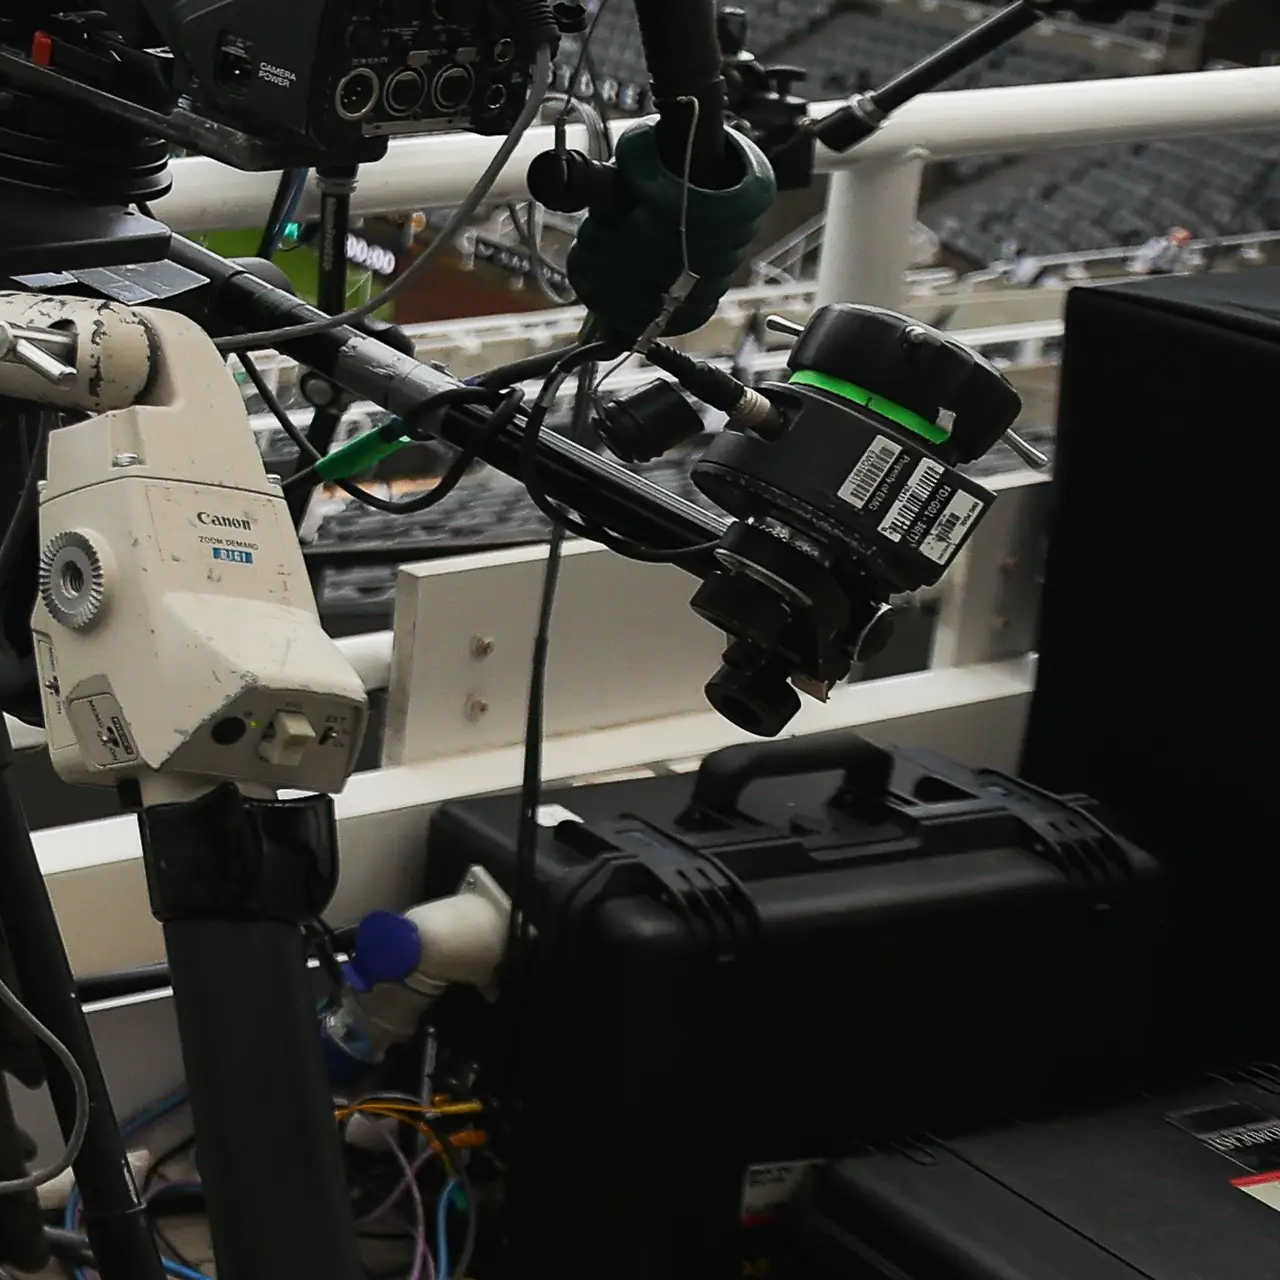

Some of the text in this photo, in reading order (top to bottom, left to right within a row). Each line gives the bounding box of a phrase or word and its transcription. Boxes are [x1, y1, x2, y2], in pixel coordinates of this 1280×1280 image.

[257, 70, 291, 89] POWER
[259, 61, 297, 82] CAMERA
[197, 511, 252, 531] Canon
[198, 535, 259, 551] ZOOM DEMAND
